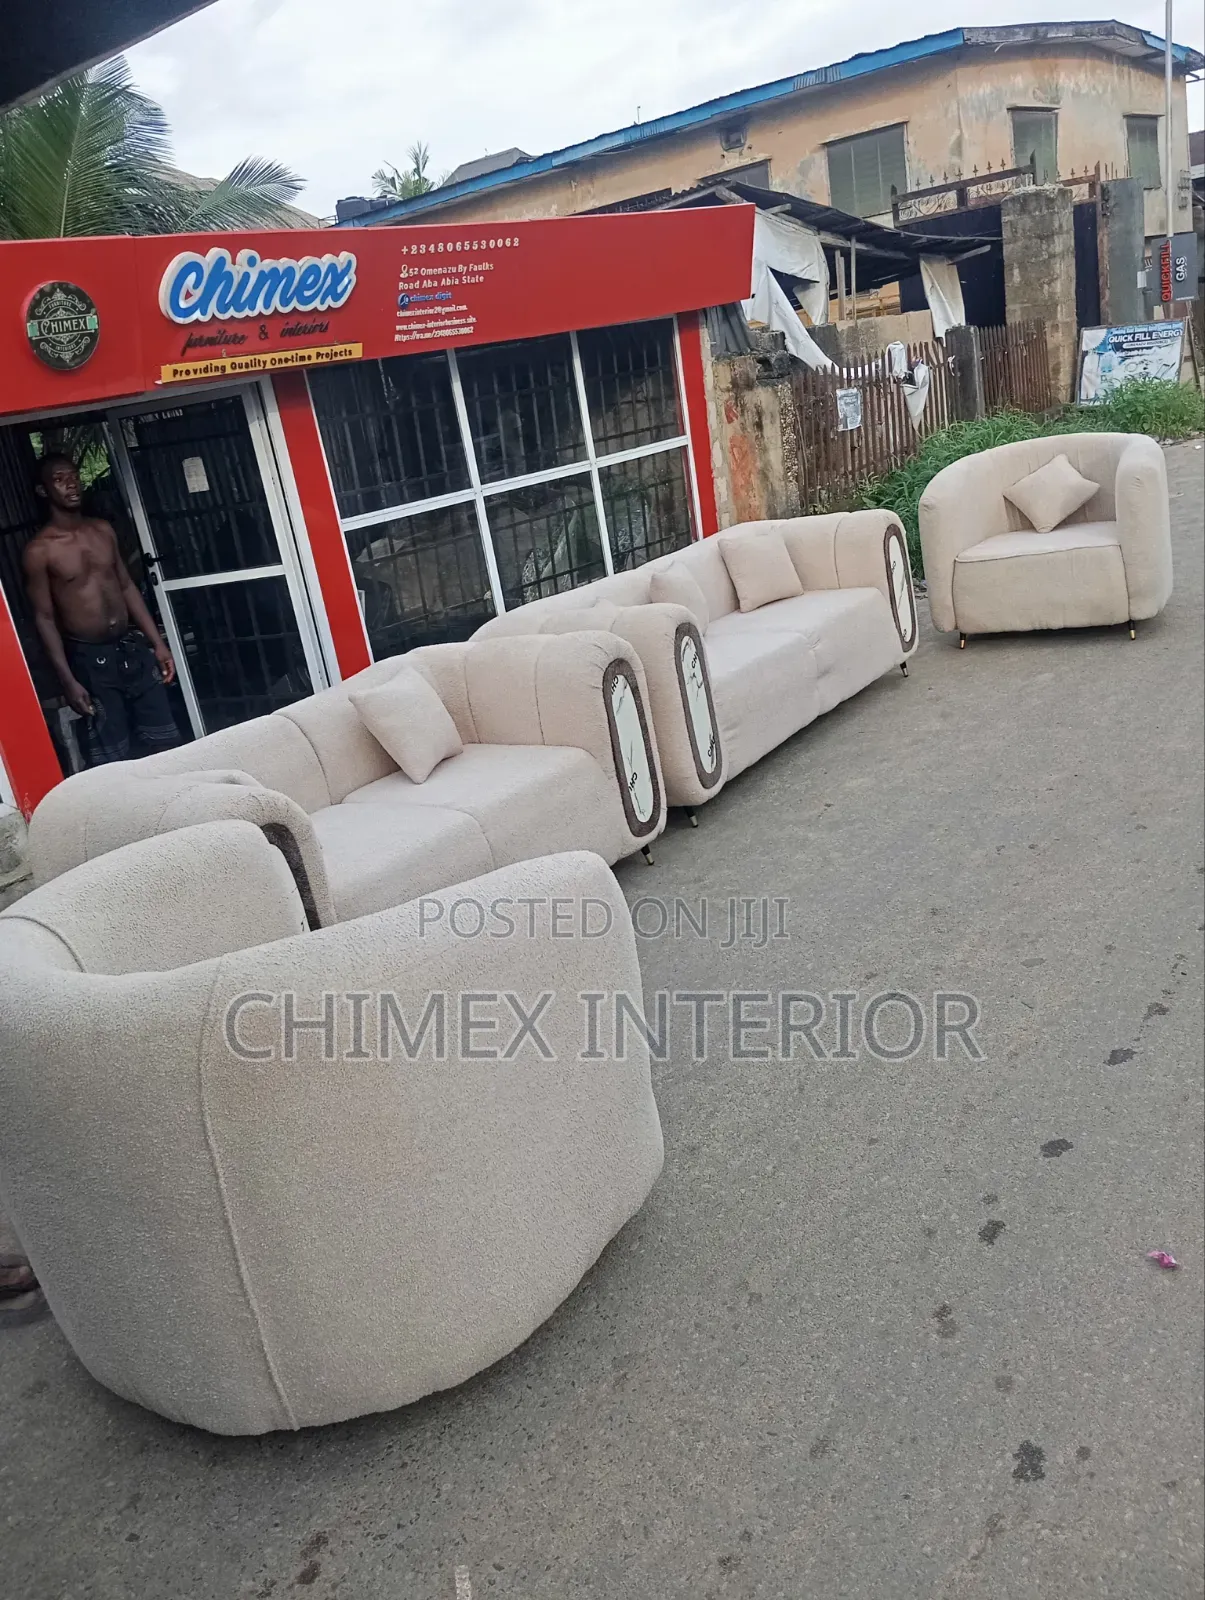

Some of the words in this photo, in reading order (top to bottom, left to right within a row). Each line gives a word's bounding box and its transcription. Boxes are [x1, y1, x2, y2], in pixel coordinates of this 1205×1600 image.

[401, 237, 520, 255] +2348065530062
[408, 269, 419, 277] 52
[420, 265, 457, 276] Omenazu
[457, 263, 468, 275] By
[468, 261, 495, 272] Faulks
[1175, 257, 1186, 281] GAS
[164, 249, 356, 323] Chimex
[398, 279, 420, 291] Road
[421, 278, 438, 289] Aba
[440, 275, 460, 287] Abia
[461, 274, 485, 285] State
[41, 318, 86, 337] CHIMEX
[258, 324, 269, 341] &
[279, 317, 330, 339] interiors
[1108, 333, 1134, 344] QUICK
[1134, 331, 1152, 342] FILL
[1151, 328, 1184, 340] ENERGY
[172, 363, 227, 378] Providing
[230, 357, 268, 371] Quality
[315, 347, 353, 360] Projects
